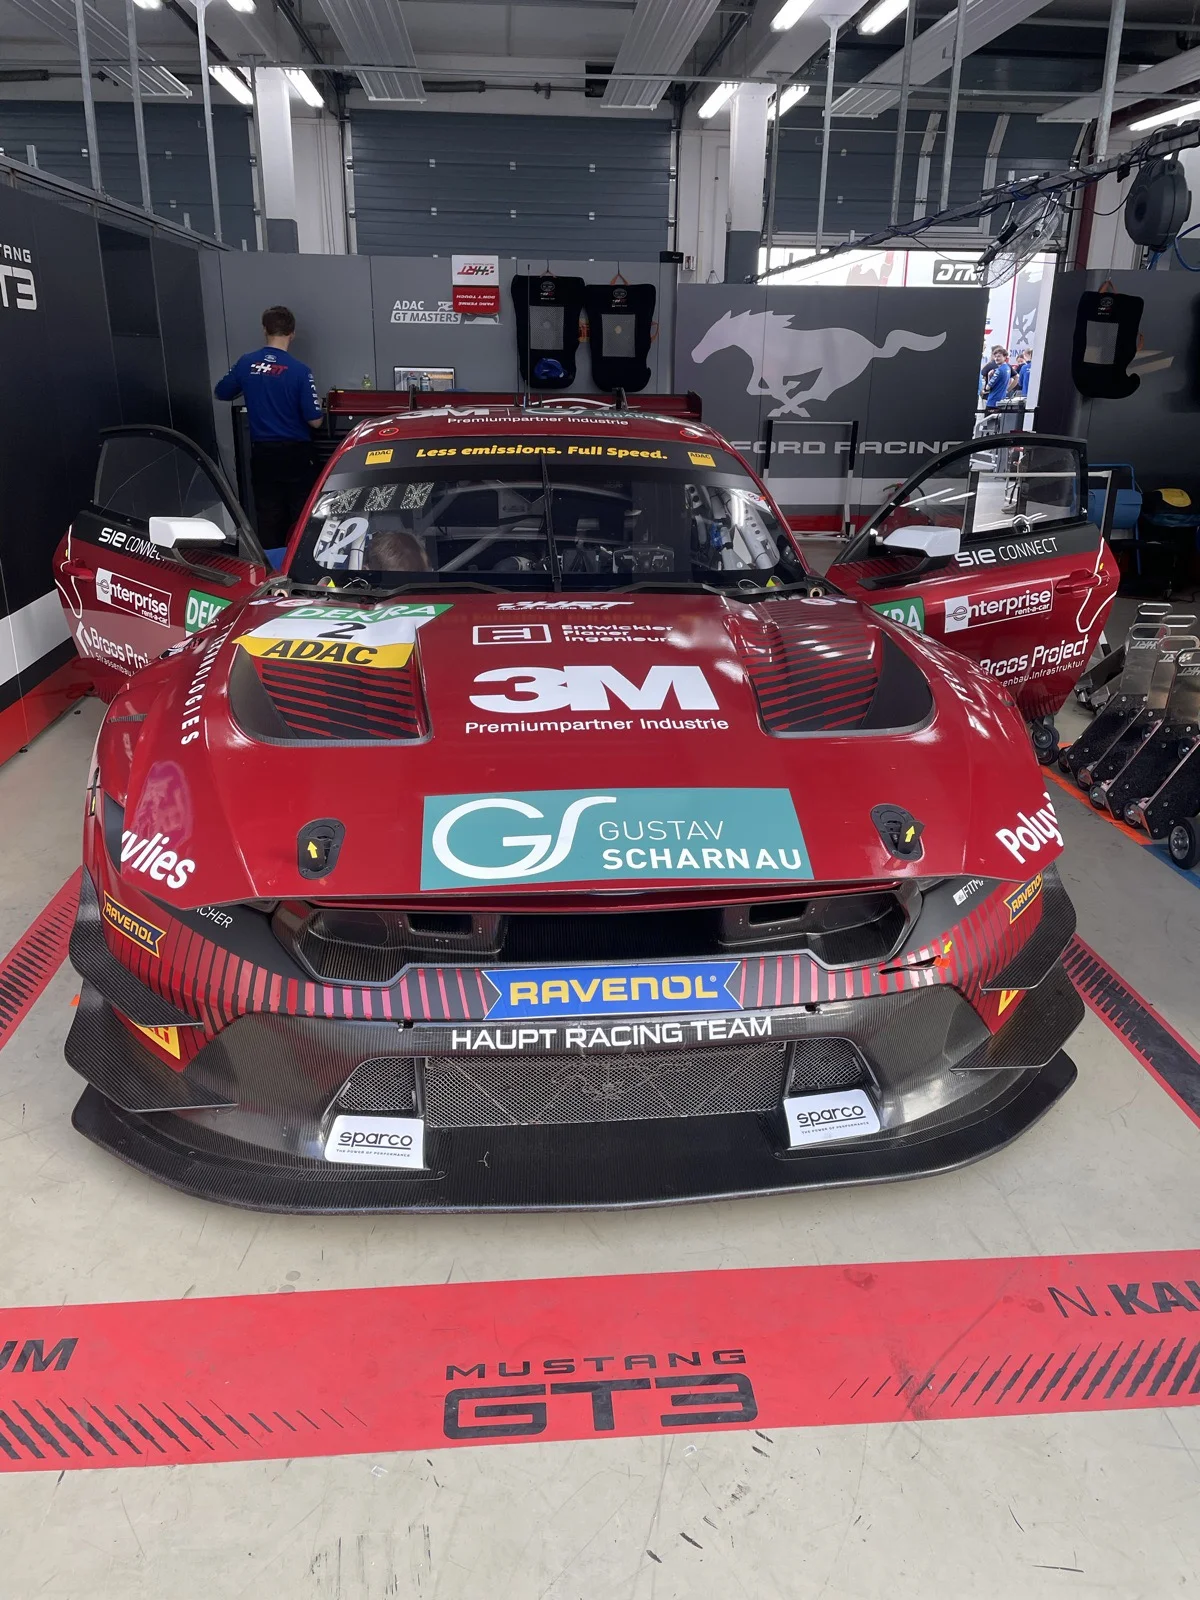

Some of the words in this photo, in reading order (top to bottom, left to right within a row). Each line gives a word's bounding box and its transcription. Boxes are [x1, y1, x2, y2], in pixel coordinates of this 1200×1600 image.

[393, 300, 425, 310] ADAC
[393, 312, 408, 322] GT
[409, 312, 459, 323] MASTERS
[447, 416, 564, 425] Premiumpartner
[567, 417, 629, 426] Industrie
[416, 448, 458, 458] Less
[461, 444, 563, 456] emissions.
[567, 445, 602, 456] Full
[606, 447, 668, 460] Speed.
[998, 537, 1059, 561] CONNECT
[98, 577, 169, 617] enterprise
[949, 589, 1052, 621] enterprise
[287, 604, 436, 622] DEKRA
[1015, 602, 1051, 616] rent-a-car
[316, 622, 368, 640] 2
[261, 640, 379, 665] ADAC
[1031, 634, 1089, 668] Project
[468, 665, 720, 714] 3M
[465, 717, 633, 734] Premiumpartner
[639, 717, 730, 731] Industrie
[599, 820, 725, 841] GUSTAV
[602, 848, 802, 870] SCHARNAU
[105, 900, 154, 946] RAVENOL
[196, 906, 234, 929] CHER
[452, 1029, 557, 1050] HAUPT
[565, 1023, 683, 1049] RACING
[689, 1016, 772, 1040] TEAM
[797, 1105, 864, 1127] sparco
[339, 1131, 413, 1148] sparco
[446, 1349, 747, 1381] MUSTANG
[443, 1373, 759, 1440] GT3
